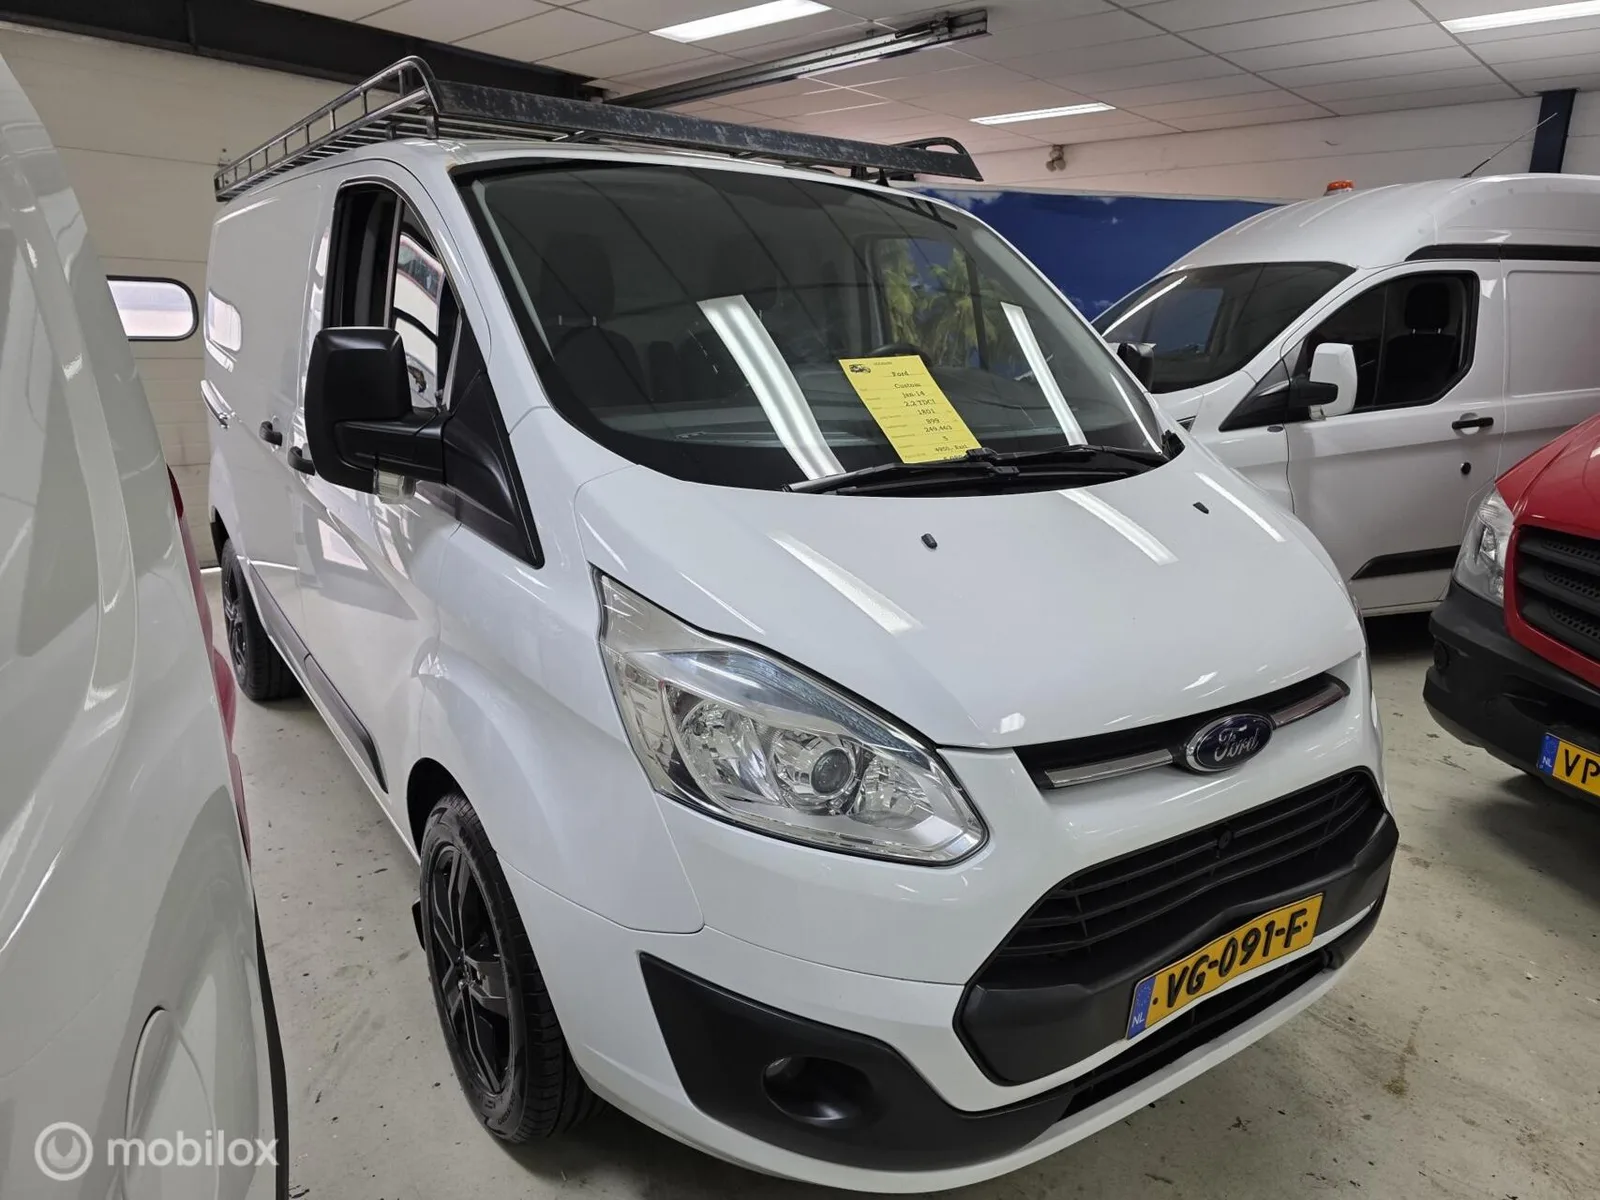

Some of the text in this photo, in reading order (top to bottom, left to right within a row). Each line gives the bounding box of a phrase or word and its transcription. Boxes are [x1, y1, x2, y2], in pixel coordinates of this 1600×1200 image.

[1214, 724, 1260, 762] Ford
[1542, 756, 1553, 768] NL
[1167, 908, 1308, 1008] VG-091-F
[1131, 1011, 1145, 1026] NL
